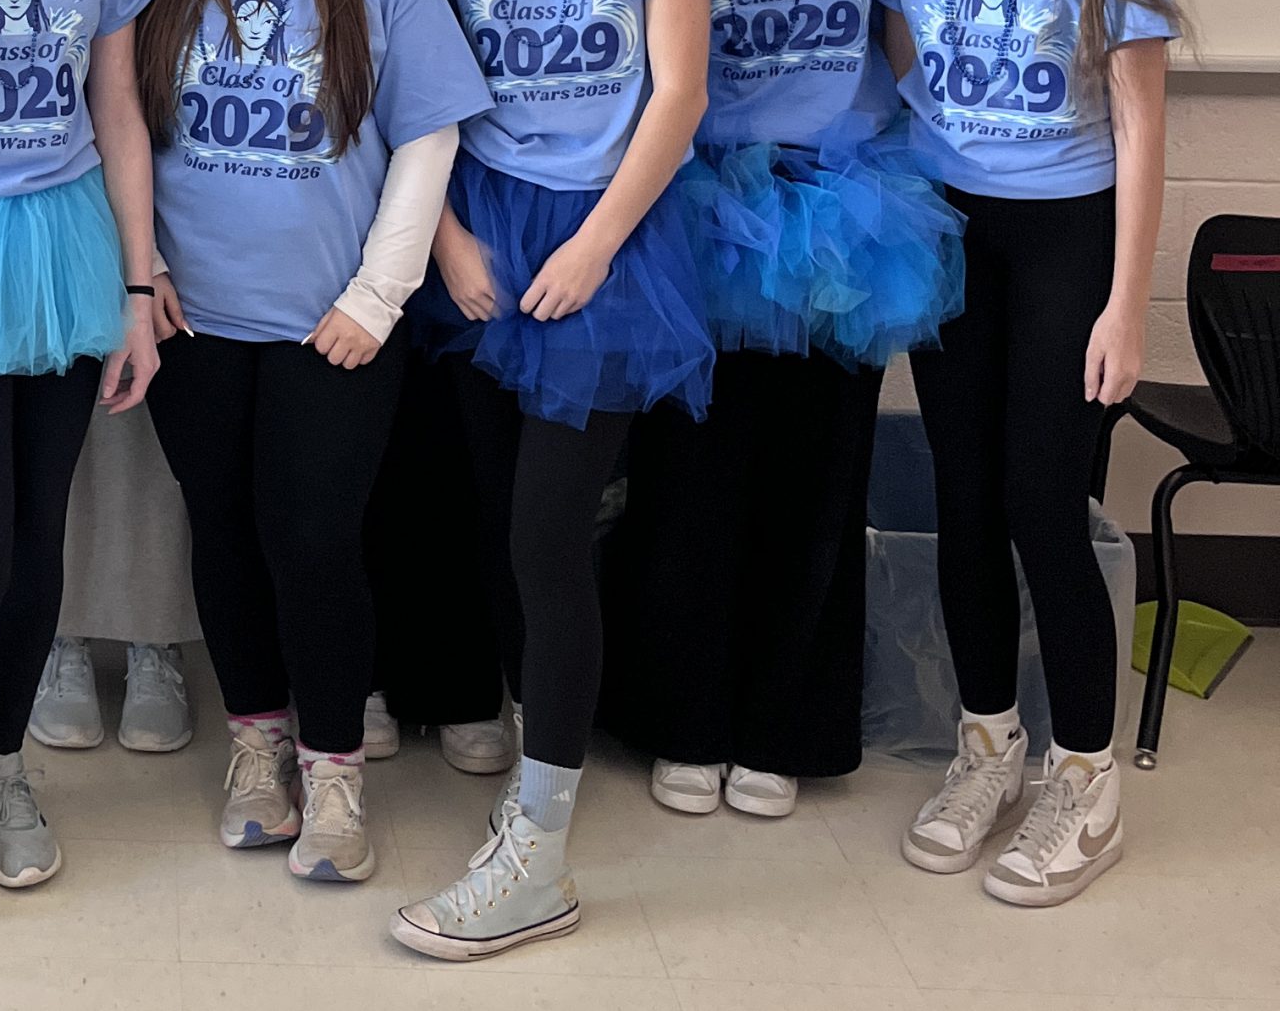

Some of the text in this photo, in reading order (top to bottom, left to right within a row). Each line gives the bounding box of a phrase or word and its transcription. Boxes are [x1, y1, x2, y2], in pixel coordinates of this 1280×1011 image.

[493, 0, 558, 21] Class
[712, 0, 861, 58] 2029
[940, 24, 1035, 58] Class of
[38, 36, 67, 63] of
[475, 21, 619, 77] 2029
[201, 65, 303, 98] Class of
[722, 66, 766, 81] Color
[810, 59, 858, 73] 2026
[923, 51, 1066, 113] 2029
[493, 82, 622, 103] lor Wars 2026
[181, 91, 325, 152] 2029
[960, 121, 1070, 139] Wars 2026
[0, 137, 47, 150] Wars
[224, 162, 321, 180] Wars 2026
